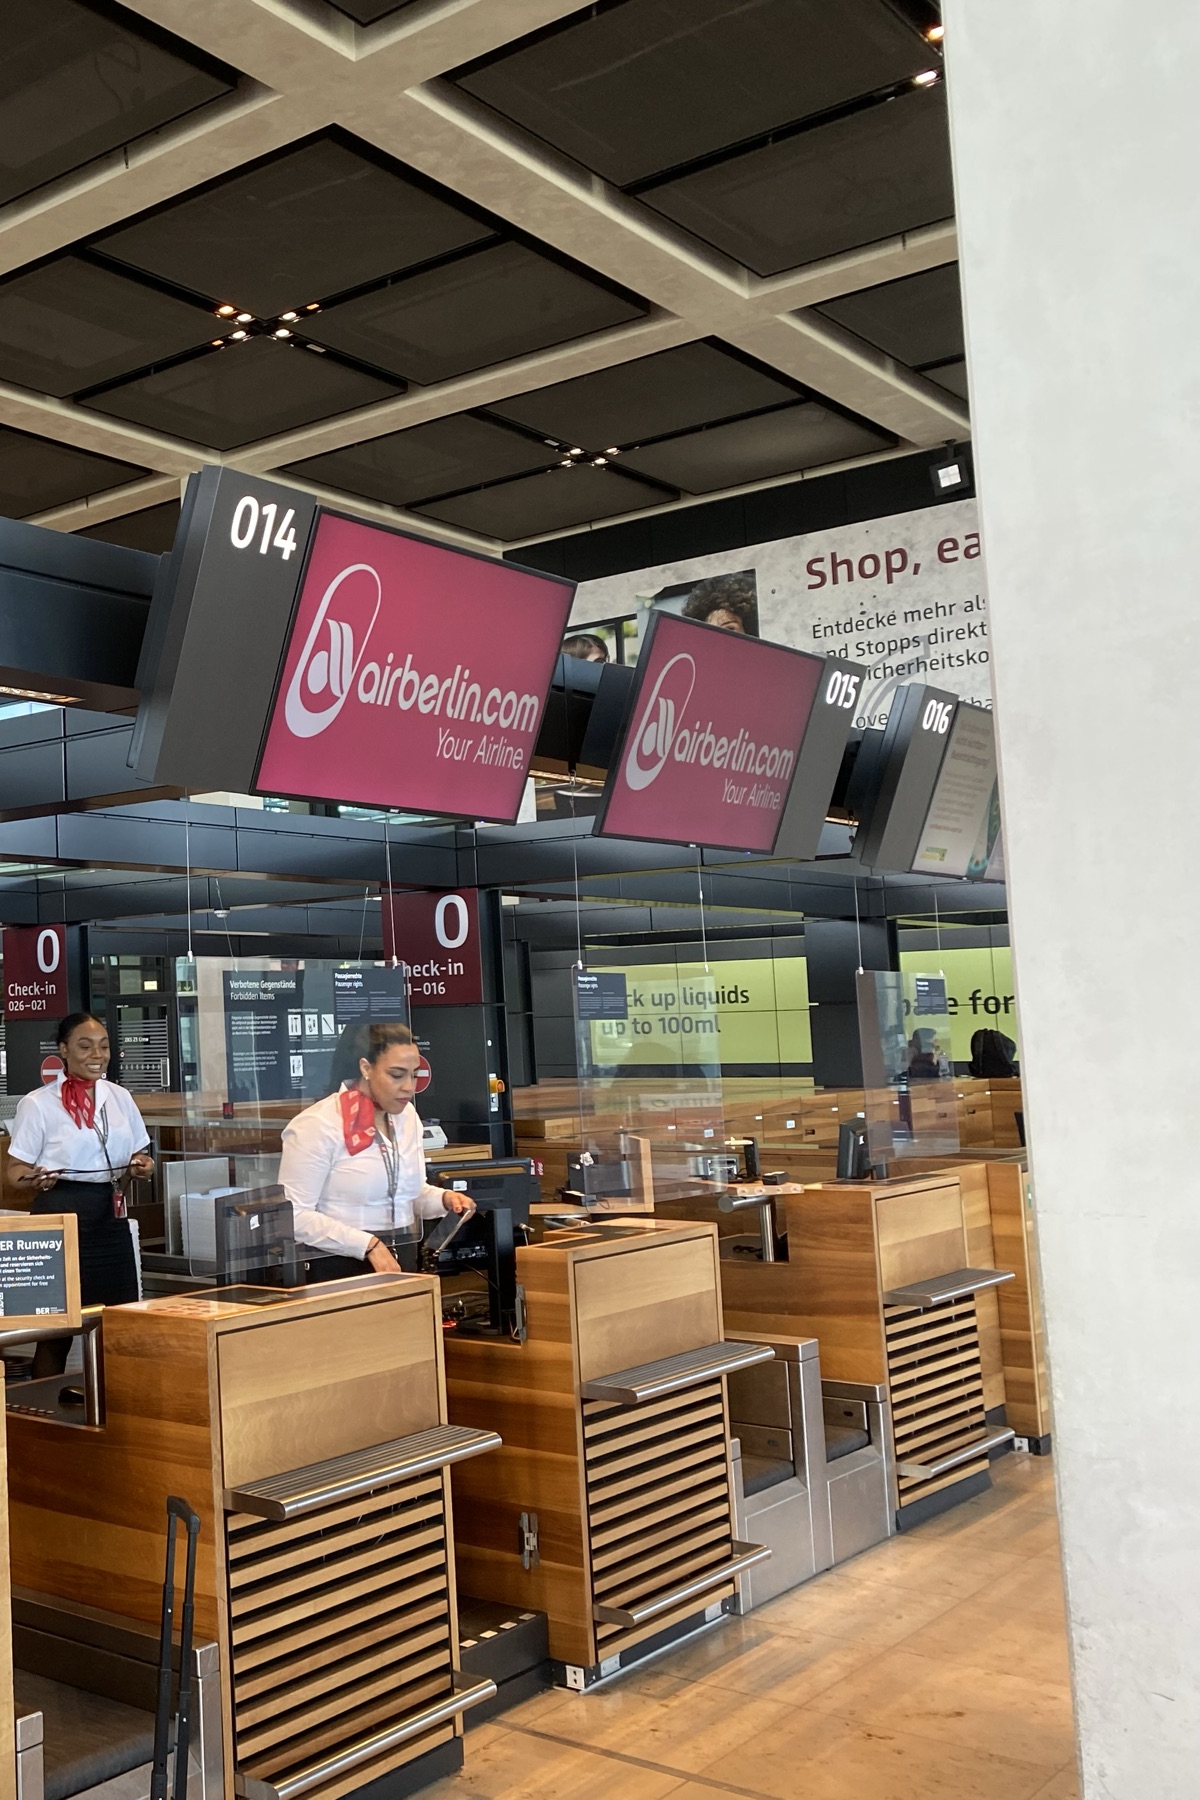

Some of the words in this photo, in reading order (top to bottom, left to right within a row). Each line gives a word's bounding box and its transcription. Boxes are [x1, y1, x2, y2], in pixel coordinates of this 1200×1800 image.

[230, 495, 297, 560] 014
[806, 547, 921, 589] Shop,
[812, 612, 897, 639] Entdecke
[904, 601, 956, 623] mehr
[855, 634, 921, 657] Stopps
[927, 621, 987, 646] direkt
[357, 652, 539, 732] airberlin.com
[826, 670, 859, 709] 015
[922, 699, 953, 734] 016
[436, 727, 472, 759] Your
[473, 734, 524, 770] Airline.
[674, 720, 794, 781] airberlin.com
[722, 778, 745, 803] Your
[748, 783, 780, 810] Airline.
[435, 894, 469, 948] 0
[37, 928, 60, 973] 0
[8, 981, 56, 996] Check-in
[229, 980, 260, 989] Verbotene
[260, 980, 297, 991] Gegenstände
[230, 991, 259, 1001] Forbidden
[259, 992, 275, 1000] Items
[652, 992, 675, 1010] up
[683, 986, 750, 1010] liquids
[969, 989, 1015, 1015] for
[602, 1021, 625, 1038] up
[632, 1019, 652, 1034] to
[17, 1240, 62, 1251] Runway
[35, 1307, 50, 1315] BER
